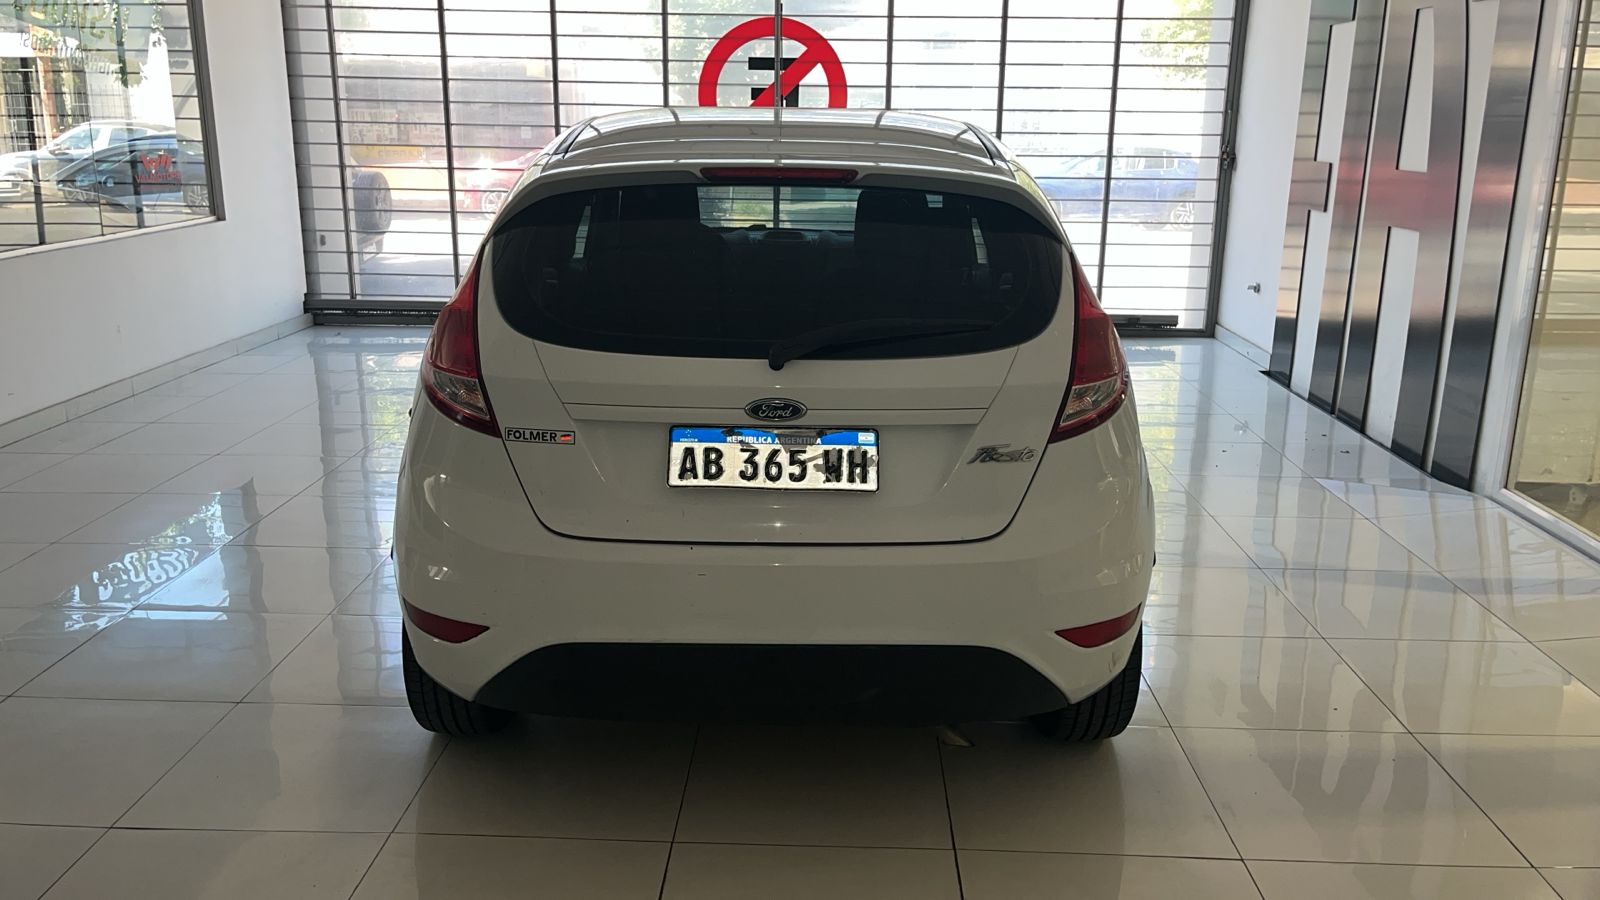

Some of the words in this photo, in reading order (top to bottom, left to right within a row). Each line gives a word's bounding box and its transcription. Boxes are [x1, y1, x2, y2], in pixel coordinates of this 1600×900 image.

[758, 403, 793, 417] Ford
[507, 429, 558, 442] FOLMER
[726, 435, 772, 444] REPUBLICA
[774, 437, 822, 445] ARGENTINA
[678, 447, 724, 481] AB
[738, 448, 807, 482] 365
